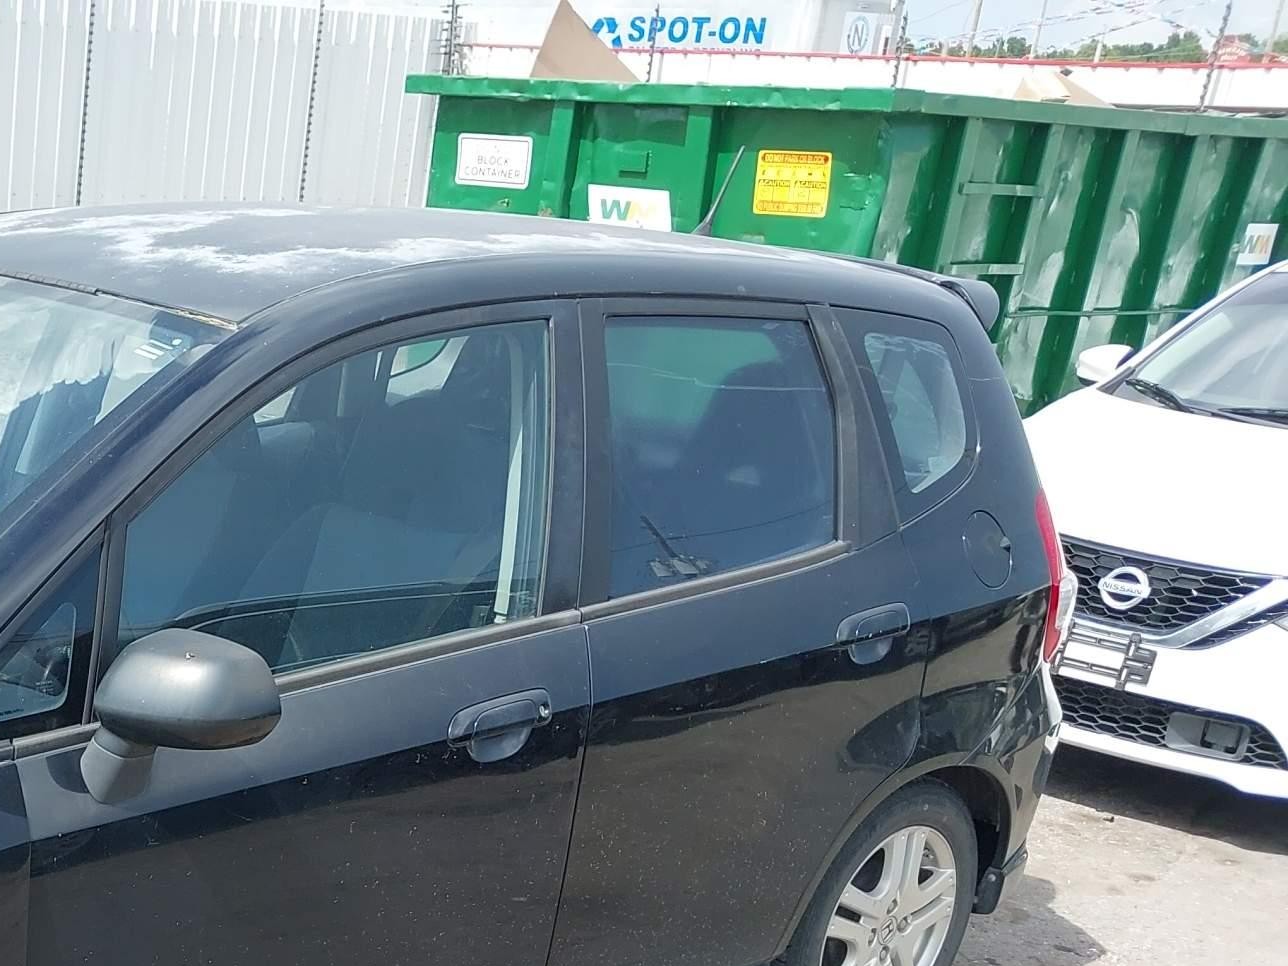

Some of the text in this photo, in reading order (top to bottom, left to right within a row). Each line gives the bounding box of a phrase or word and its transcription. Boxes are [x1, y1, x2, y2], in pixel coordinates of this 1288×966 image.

[628, 16, 767, 44] SPOT-ON
[464, 166, 521, 179] CONTAINER
[1103, 581, 1143, 595] NISSAN
